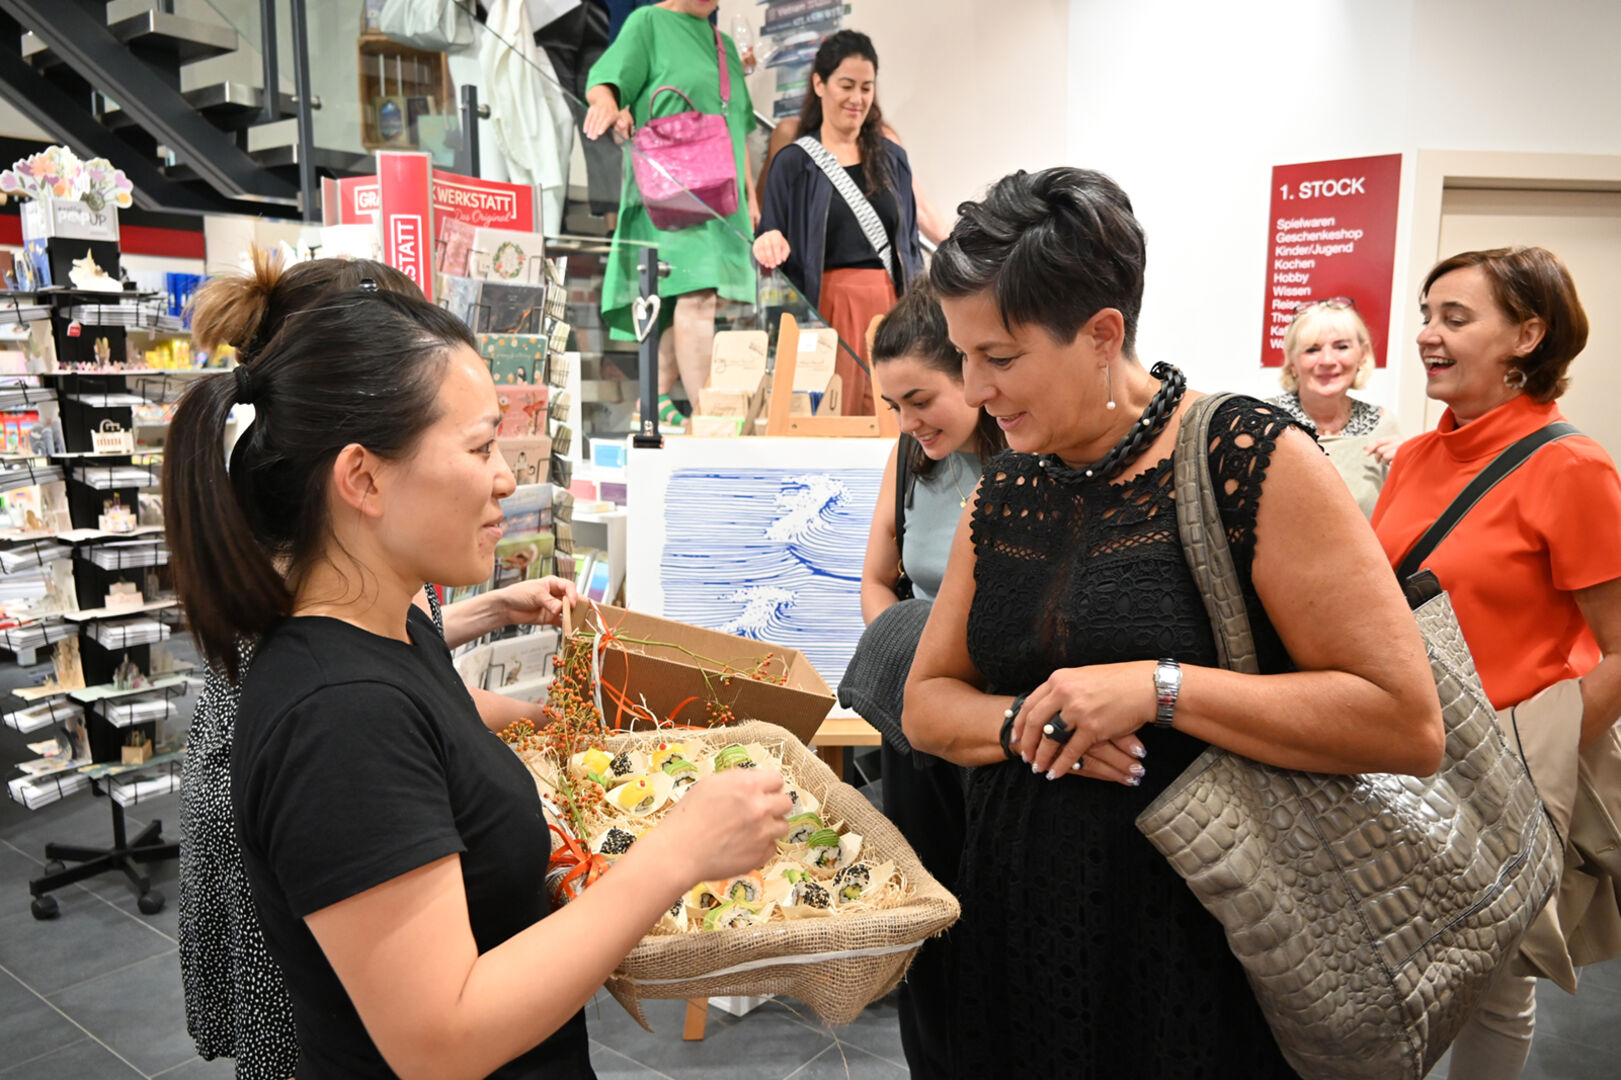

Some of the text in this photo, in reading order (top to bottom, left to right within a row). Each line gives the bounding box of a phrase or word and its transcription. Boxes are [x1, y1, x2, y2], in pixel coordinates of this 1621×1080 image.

[1280, 177, 1366, 200] 1. STOCK
[471, 209, 511, 228] Original
[1276, 217, 1336, 231] Spielwaren
[1275, 229, 1364, 243] Geschenkeshop
[1275, 242, 1354, 256] Kinder/Jugend
[1274, 258, 1316, 270] Kochen
[1273, 272, 1310, 285] Hobby
[1273, 285, 1312, 297] Wissen
